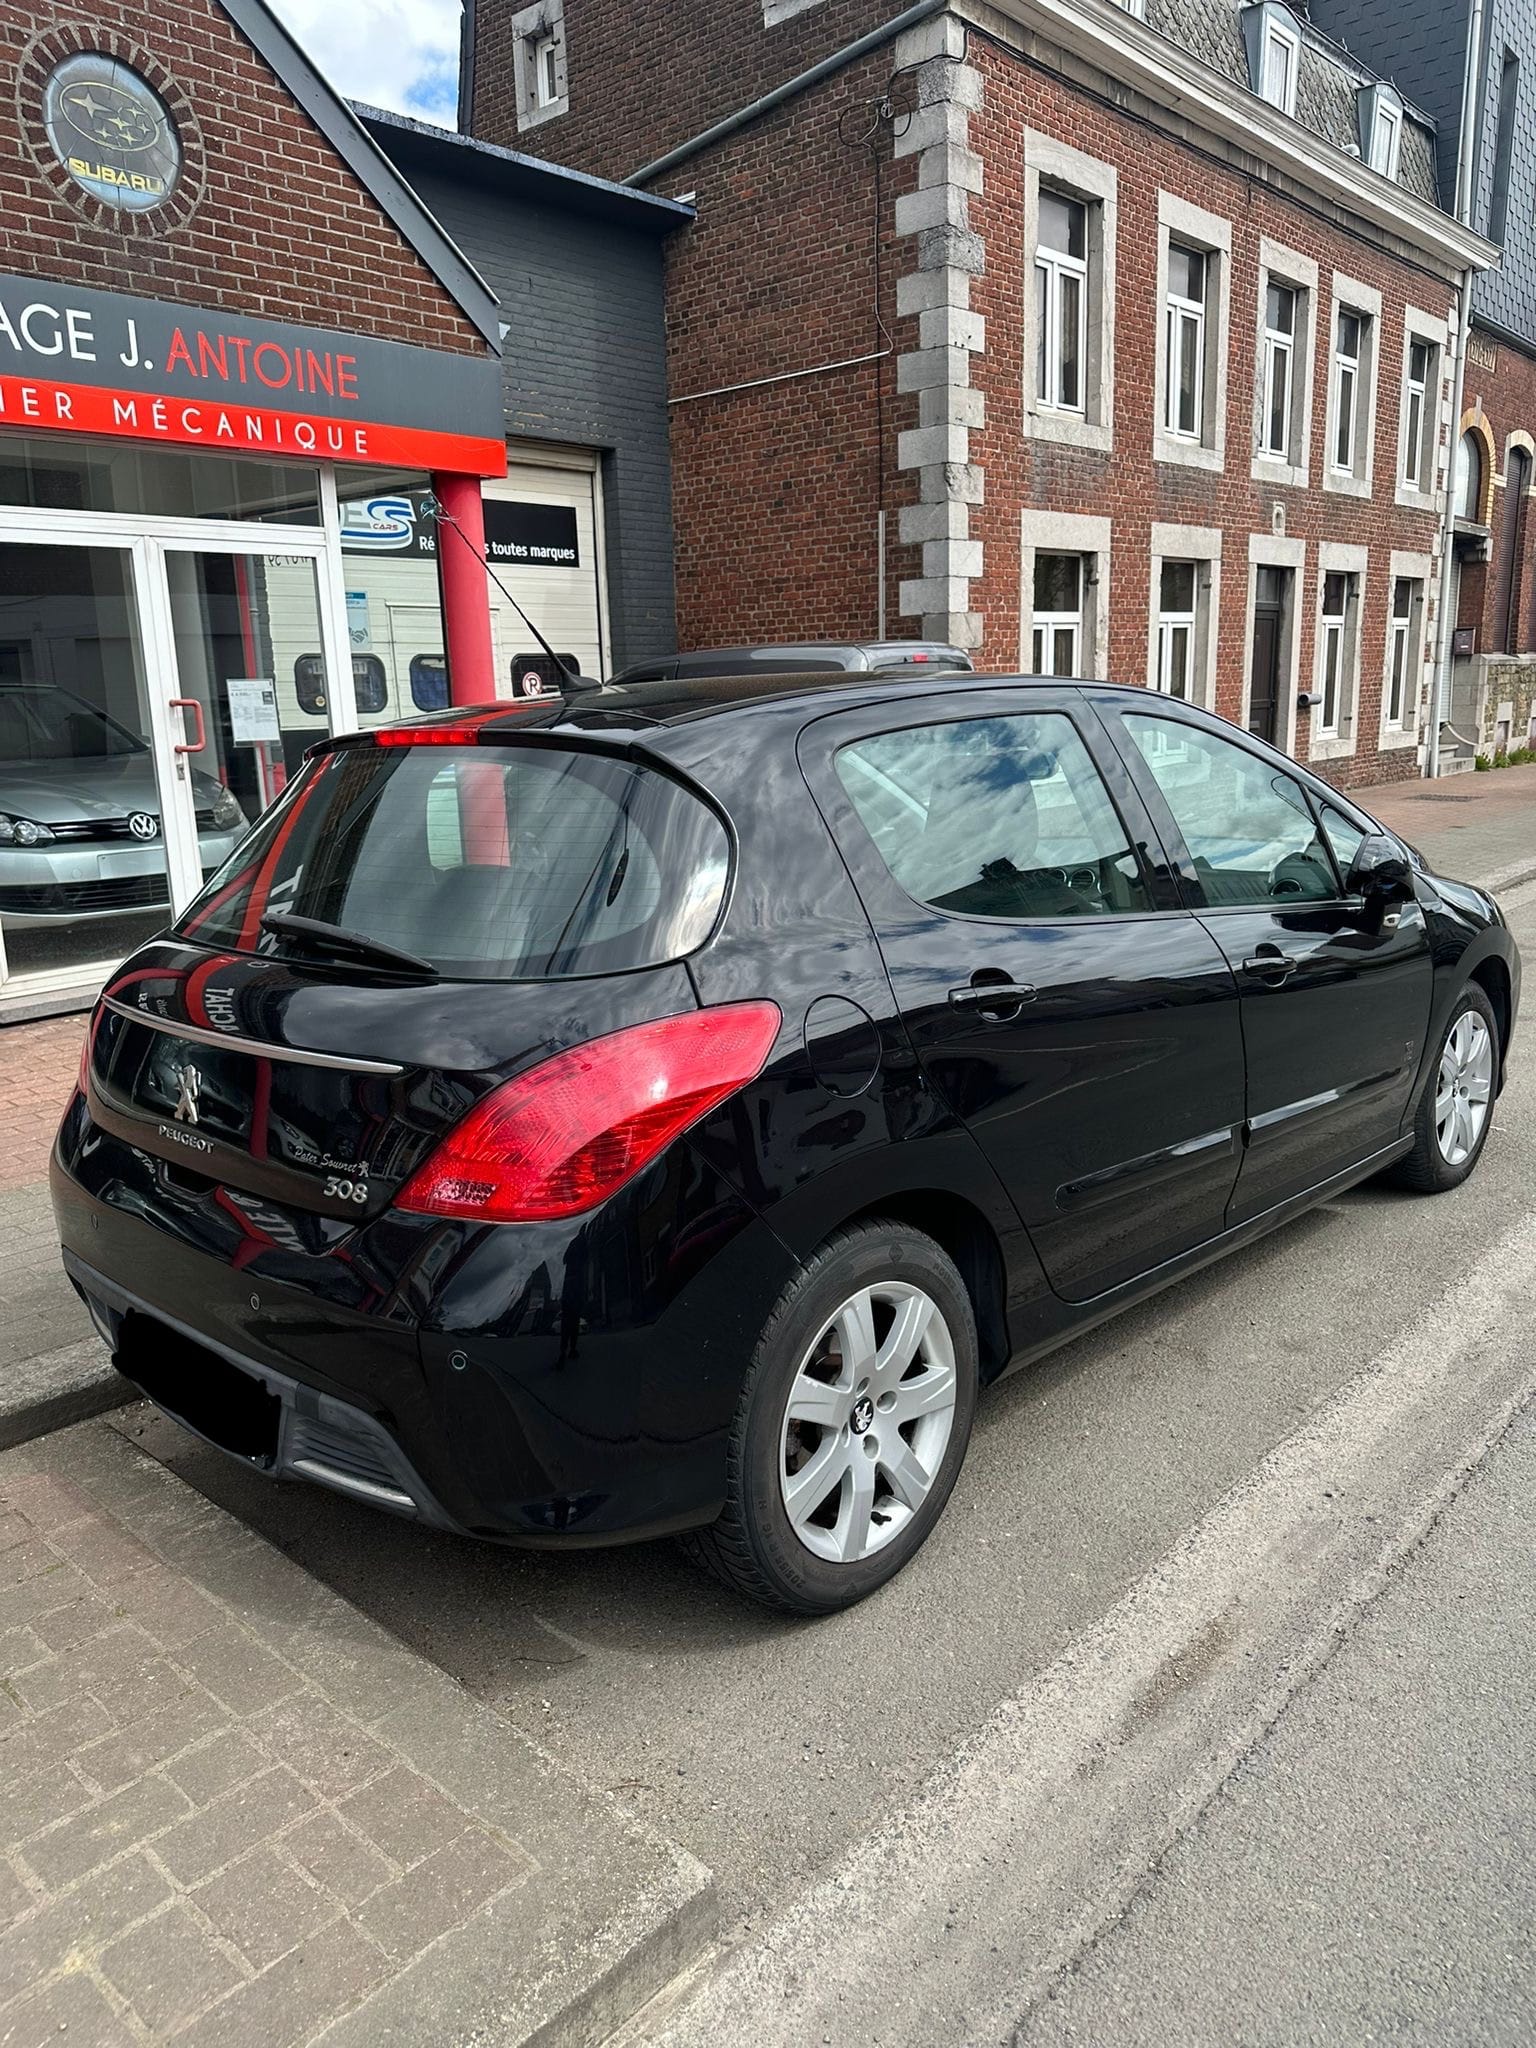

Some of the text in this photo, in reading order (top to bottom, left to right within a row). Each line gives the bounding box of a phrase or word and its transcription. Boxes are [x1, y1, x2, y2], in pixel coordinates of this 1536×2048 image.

[69, 157, 165, 194] SUBARU
[119, 319, 154, 370] J.
[165, 327, 359, 400] ANTOINE
[112, 398, 368, 454] MÉCANIQUE
[372, 523, 399, 531] CARS
[492, 542, 528, 557] toutes
[530, 545, 575, 562] marques
[158, 1124, 214, 1154] PEUGEOT
[323, 1175, 369, 1204] 308
